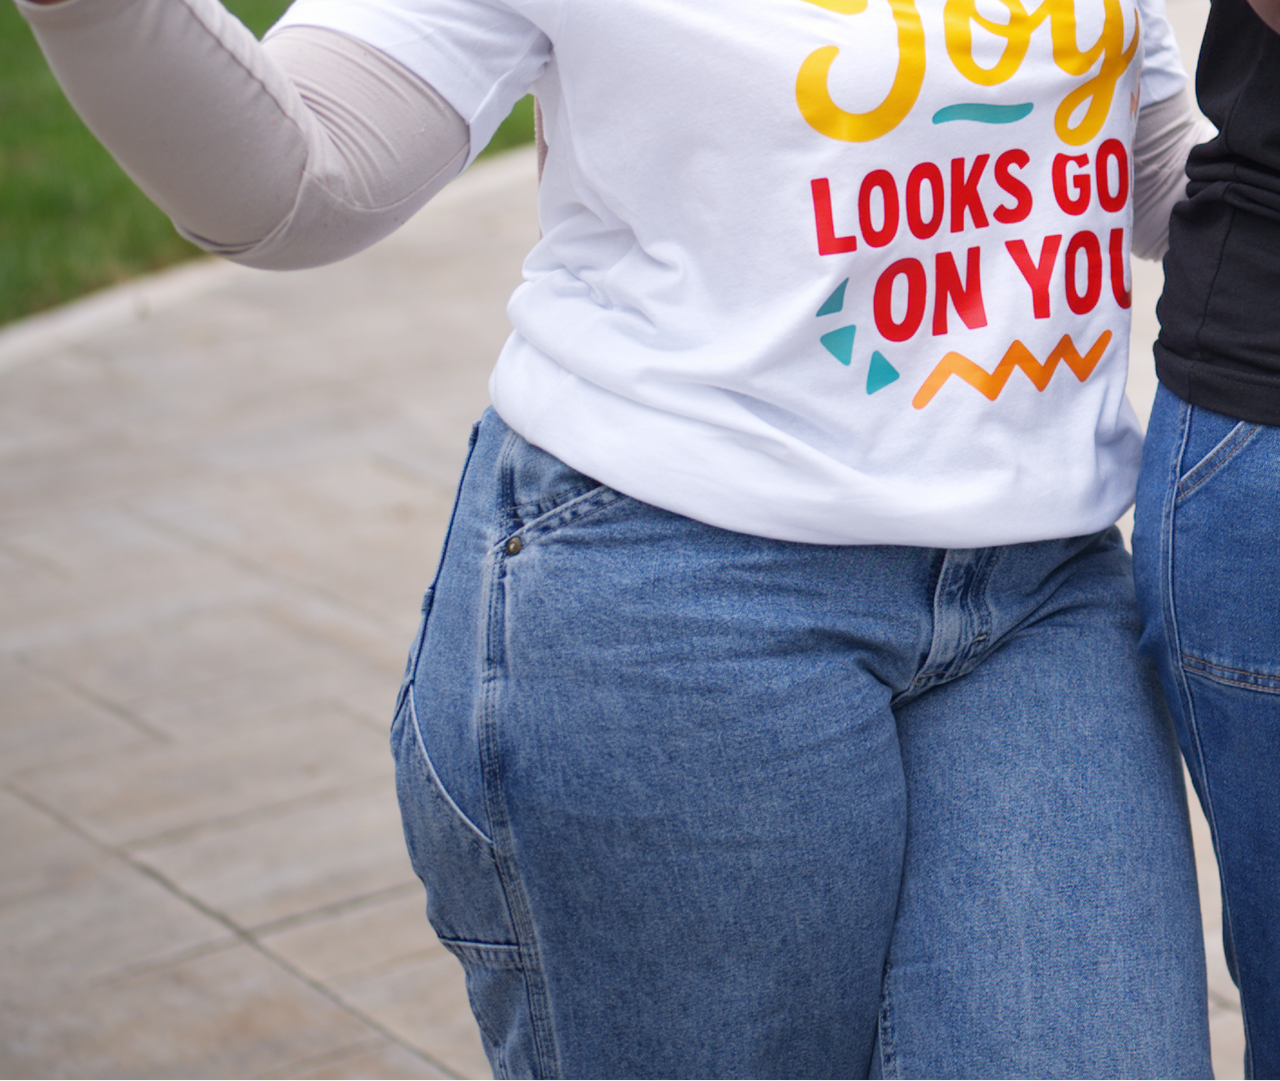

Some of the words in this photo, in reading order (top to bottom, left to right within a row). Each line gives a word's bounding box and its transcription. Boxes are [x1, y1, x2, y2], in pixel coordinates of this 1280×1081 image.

[811, 148, 1034, 257] LOOKS
[1051, 138, 1130, 217] GO
[872, 246, 988, 343] ON
[1004, 227, 1133, 320] YOU
